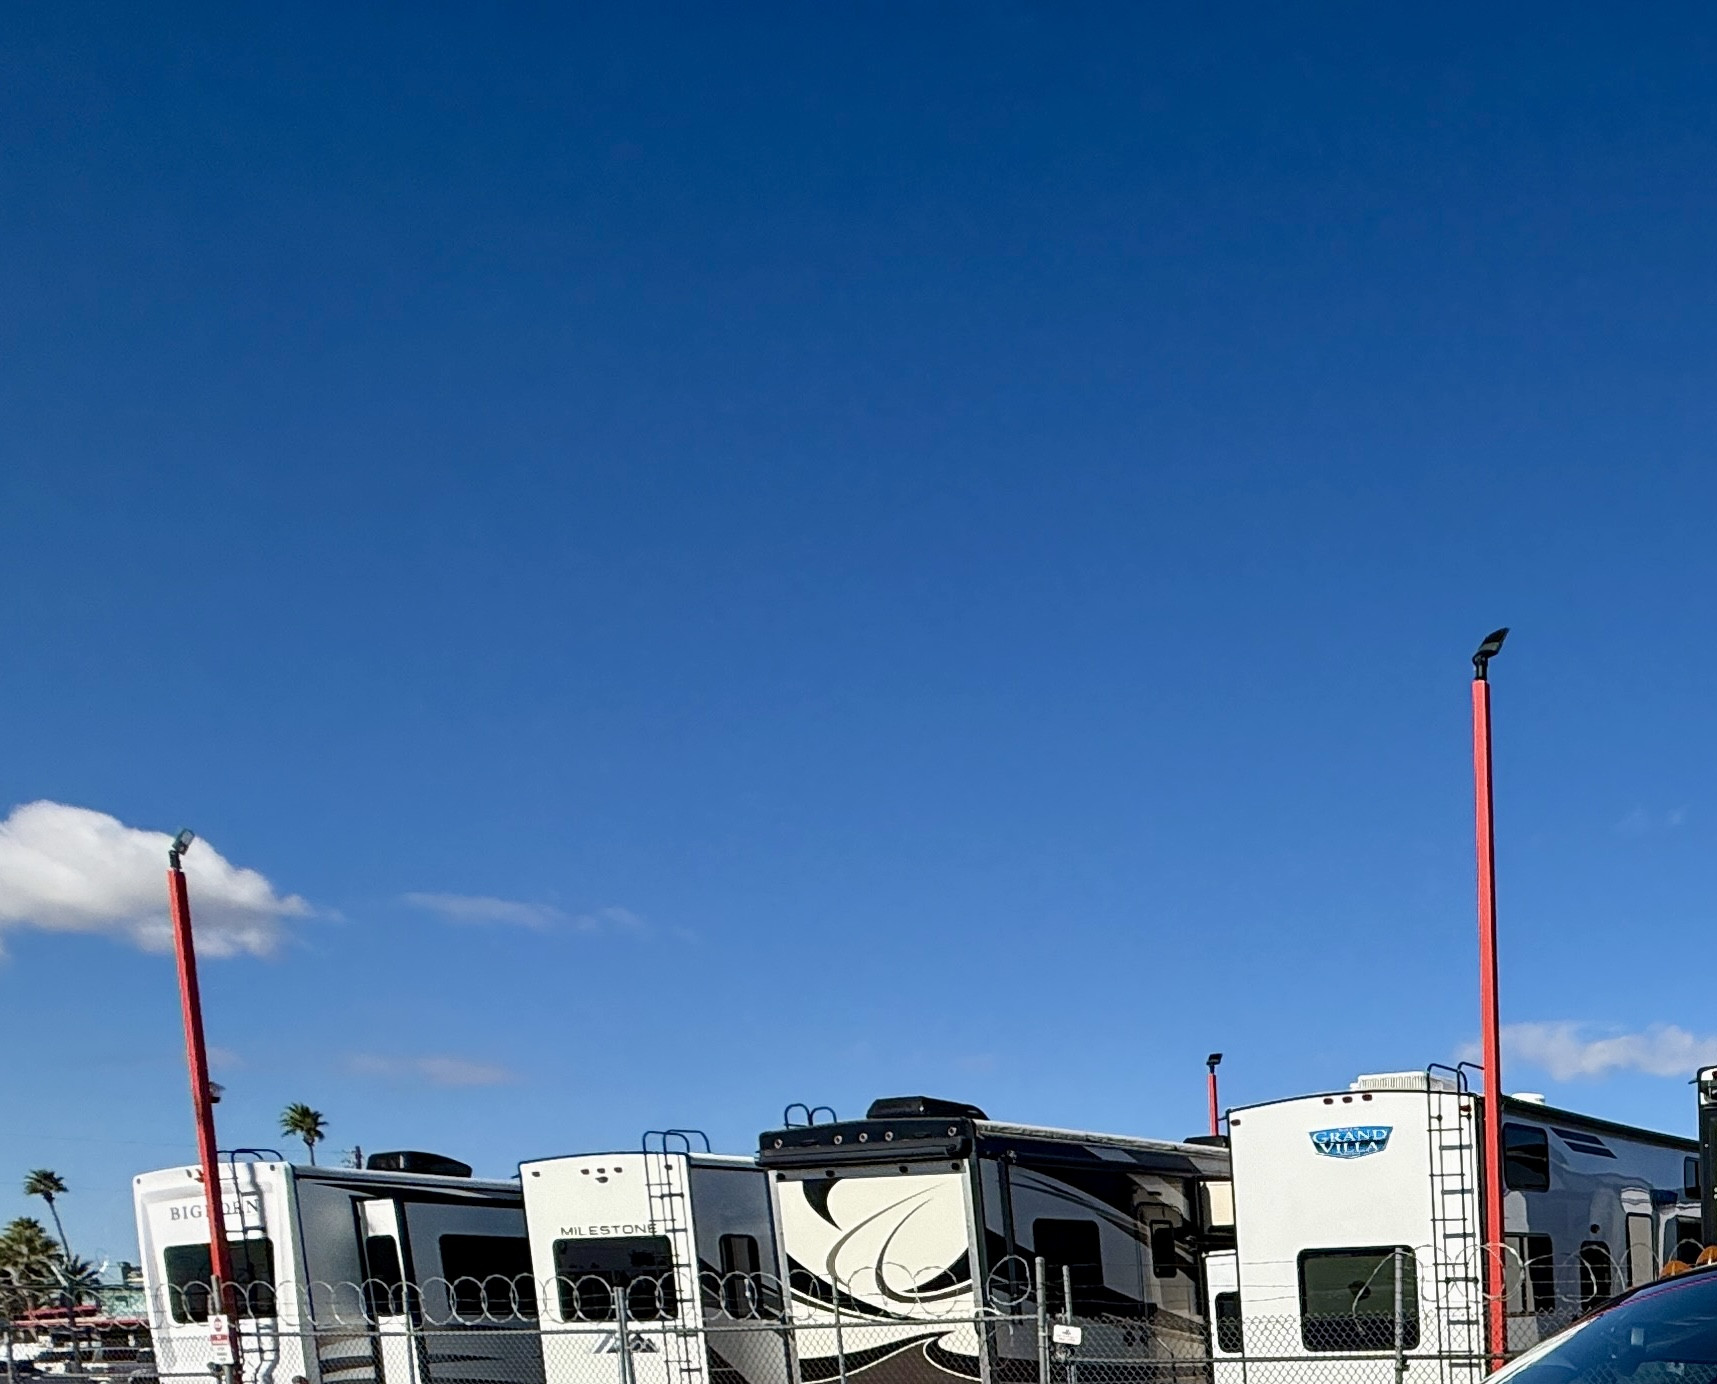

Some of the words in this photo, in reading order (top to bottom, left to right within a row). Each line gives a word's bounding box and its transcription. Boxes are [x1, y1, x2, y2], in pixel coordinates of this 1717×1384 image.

[1313, 1130, 1387, 1144] GRAND
[1319, 1141, 1379, 1154] VILLA
[170, 1199, 260, 1220] BIGORN
[560, 1223, 657, 1236] MILESTONE
